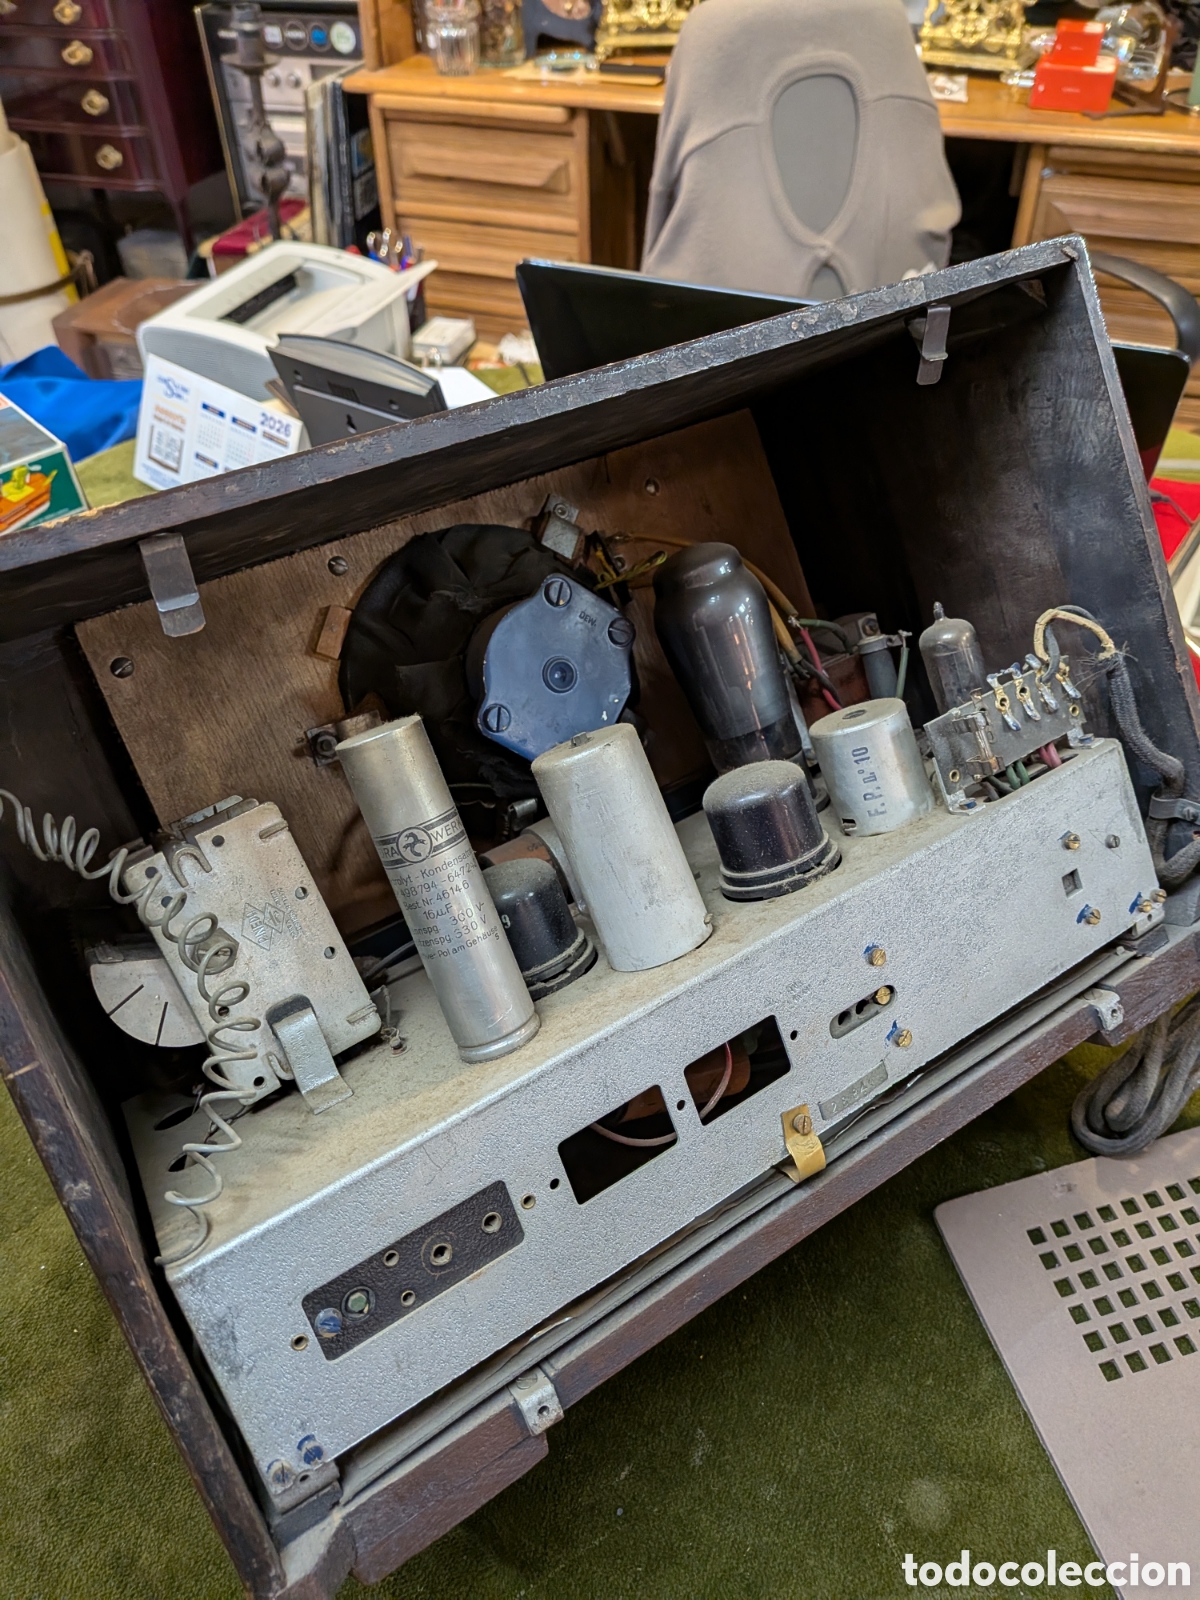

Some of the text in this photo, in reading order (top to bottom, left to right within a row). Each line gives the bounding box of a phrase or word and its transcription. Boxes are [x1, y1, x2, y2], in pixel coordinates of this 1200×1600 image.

[259, 412, 292, 437] 2026
[436, 879, 470, 902] 46146
[449, 907, 474, 926] 300
[480, 914, 487, 925] V
[451, 944, 466, 955] am
[466, 925, 498, 948] Gehäuse
